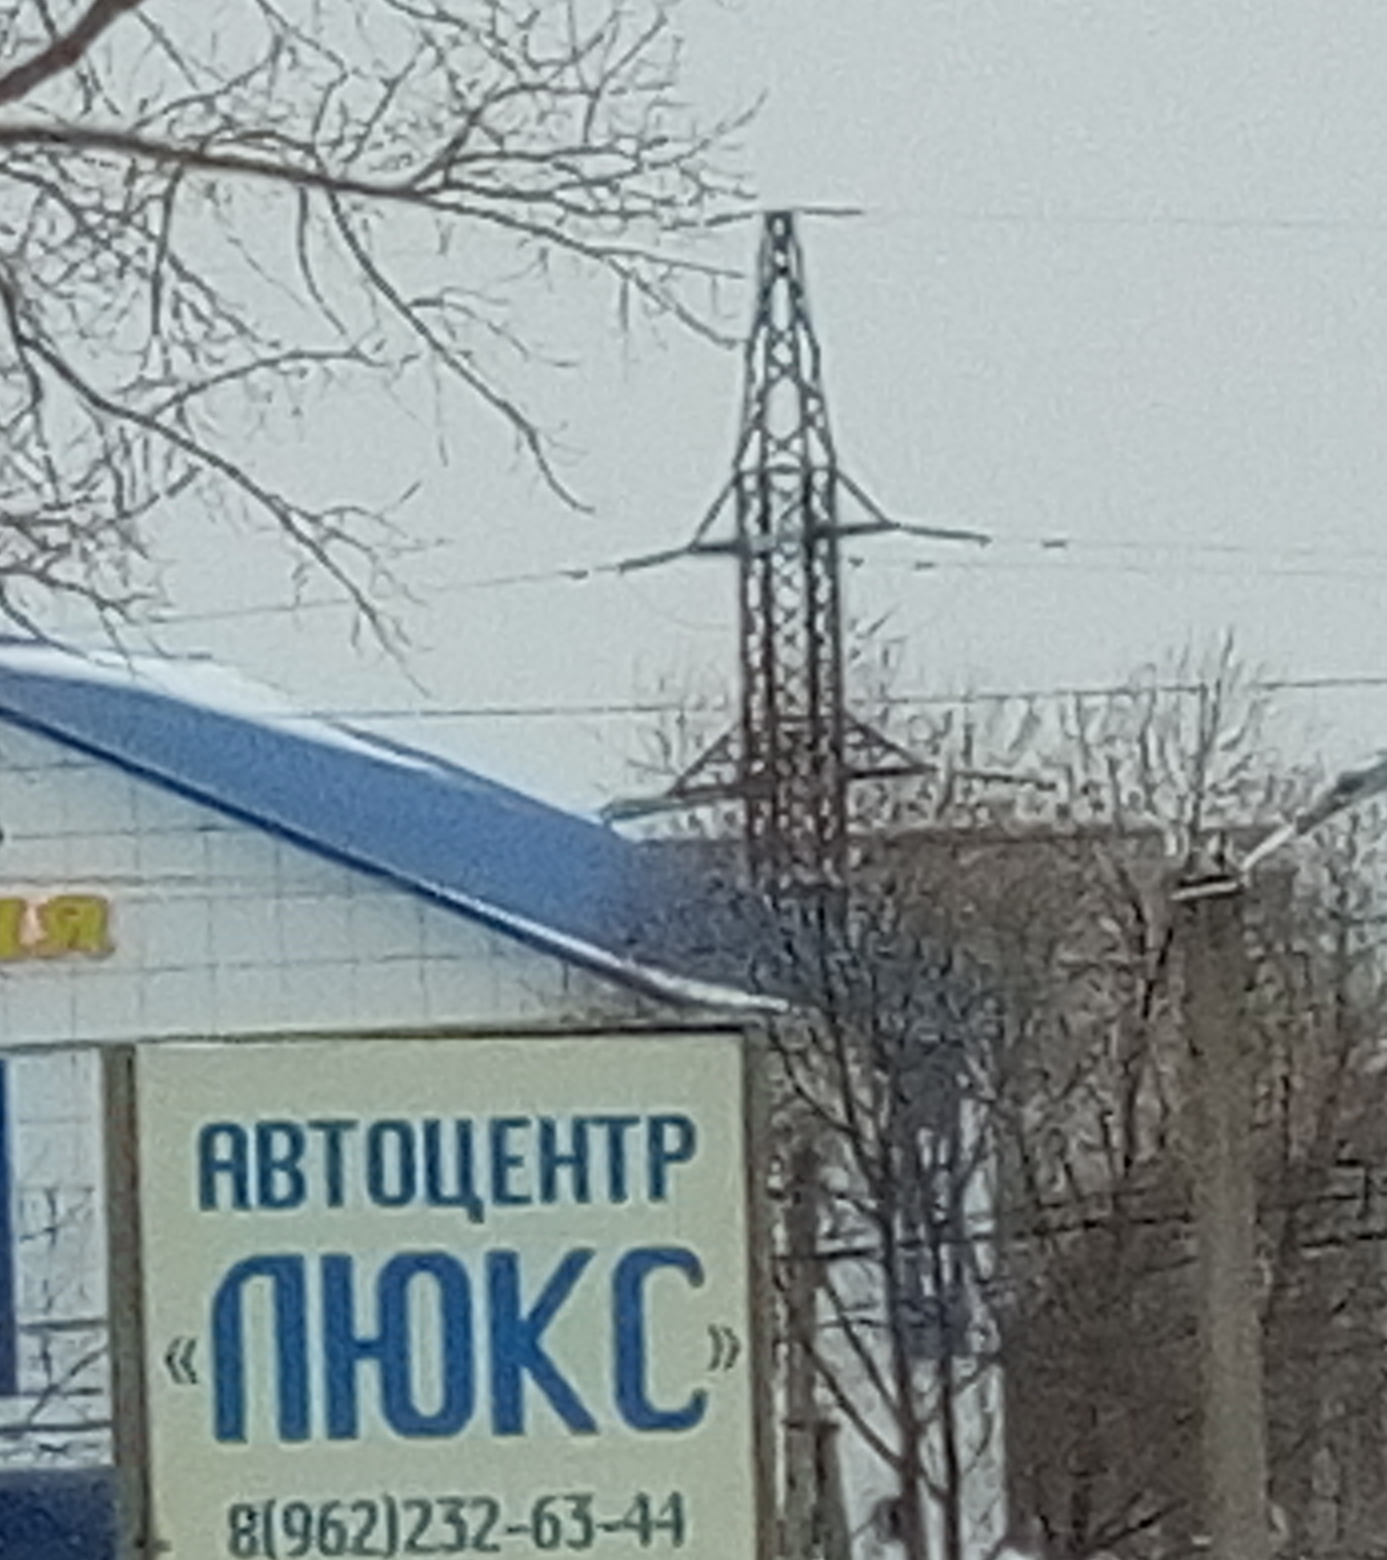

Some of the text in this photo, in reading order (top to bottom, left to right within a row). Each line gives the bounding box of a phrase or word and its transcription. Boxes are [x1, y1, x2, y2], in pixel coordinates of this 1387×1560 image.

[197, 1113, 698, 1224] АВТОЦЕНТР
[164, 1246, 743, 1444] «ЛЮКС»
[227, 1491, 686, 1560] 8(962)232-63-44
